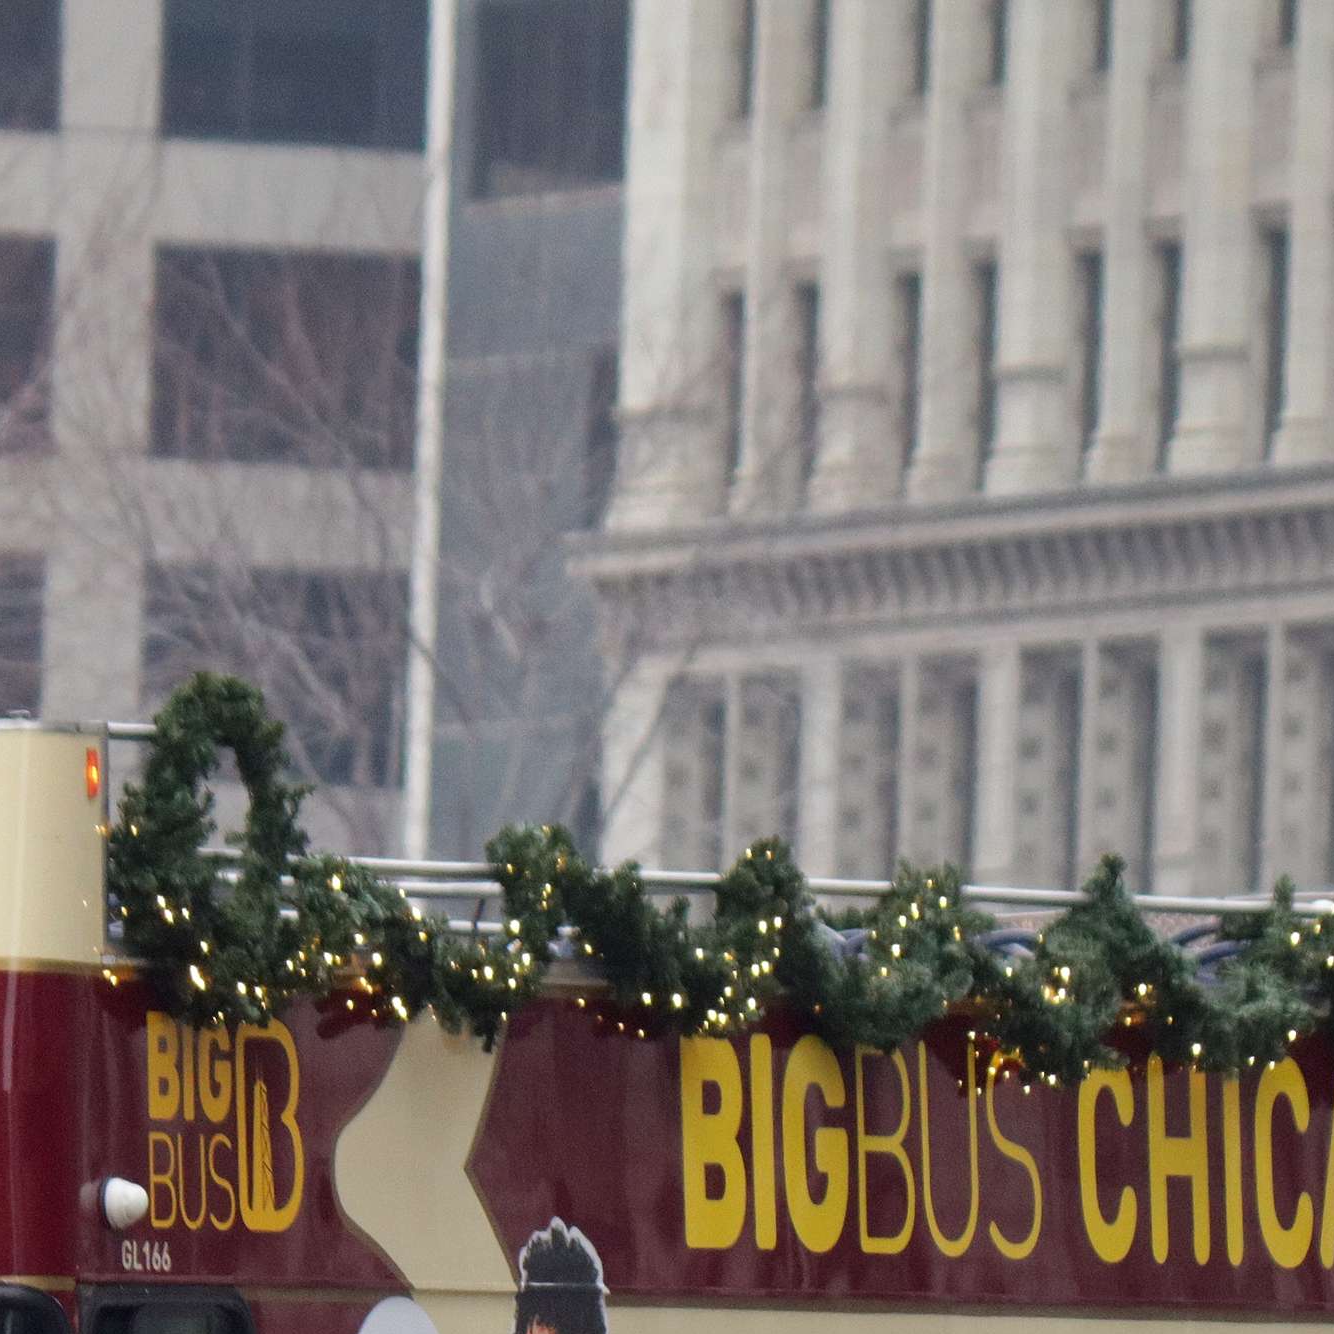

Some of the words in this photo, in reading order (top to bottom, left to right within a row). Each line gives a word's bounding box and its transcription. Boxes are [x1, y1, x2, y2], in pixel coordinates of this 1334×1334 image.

[146, 1010, 233, 1124] BIG
[149, 1131, 236, 1231] BUS
[121, 1240, 171, 1272] GL166
